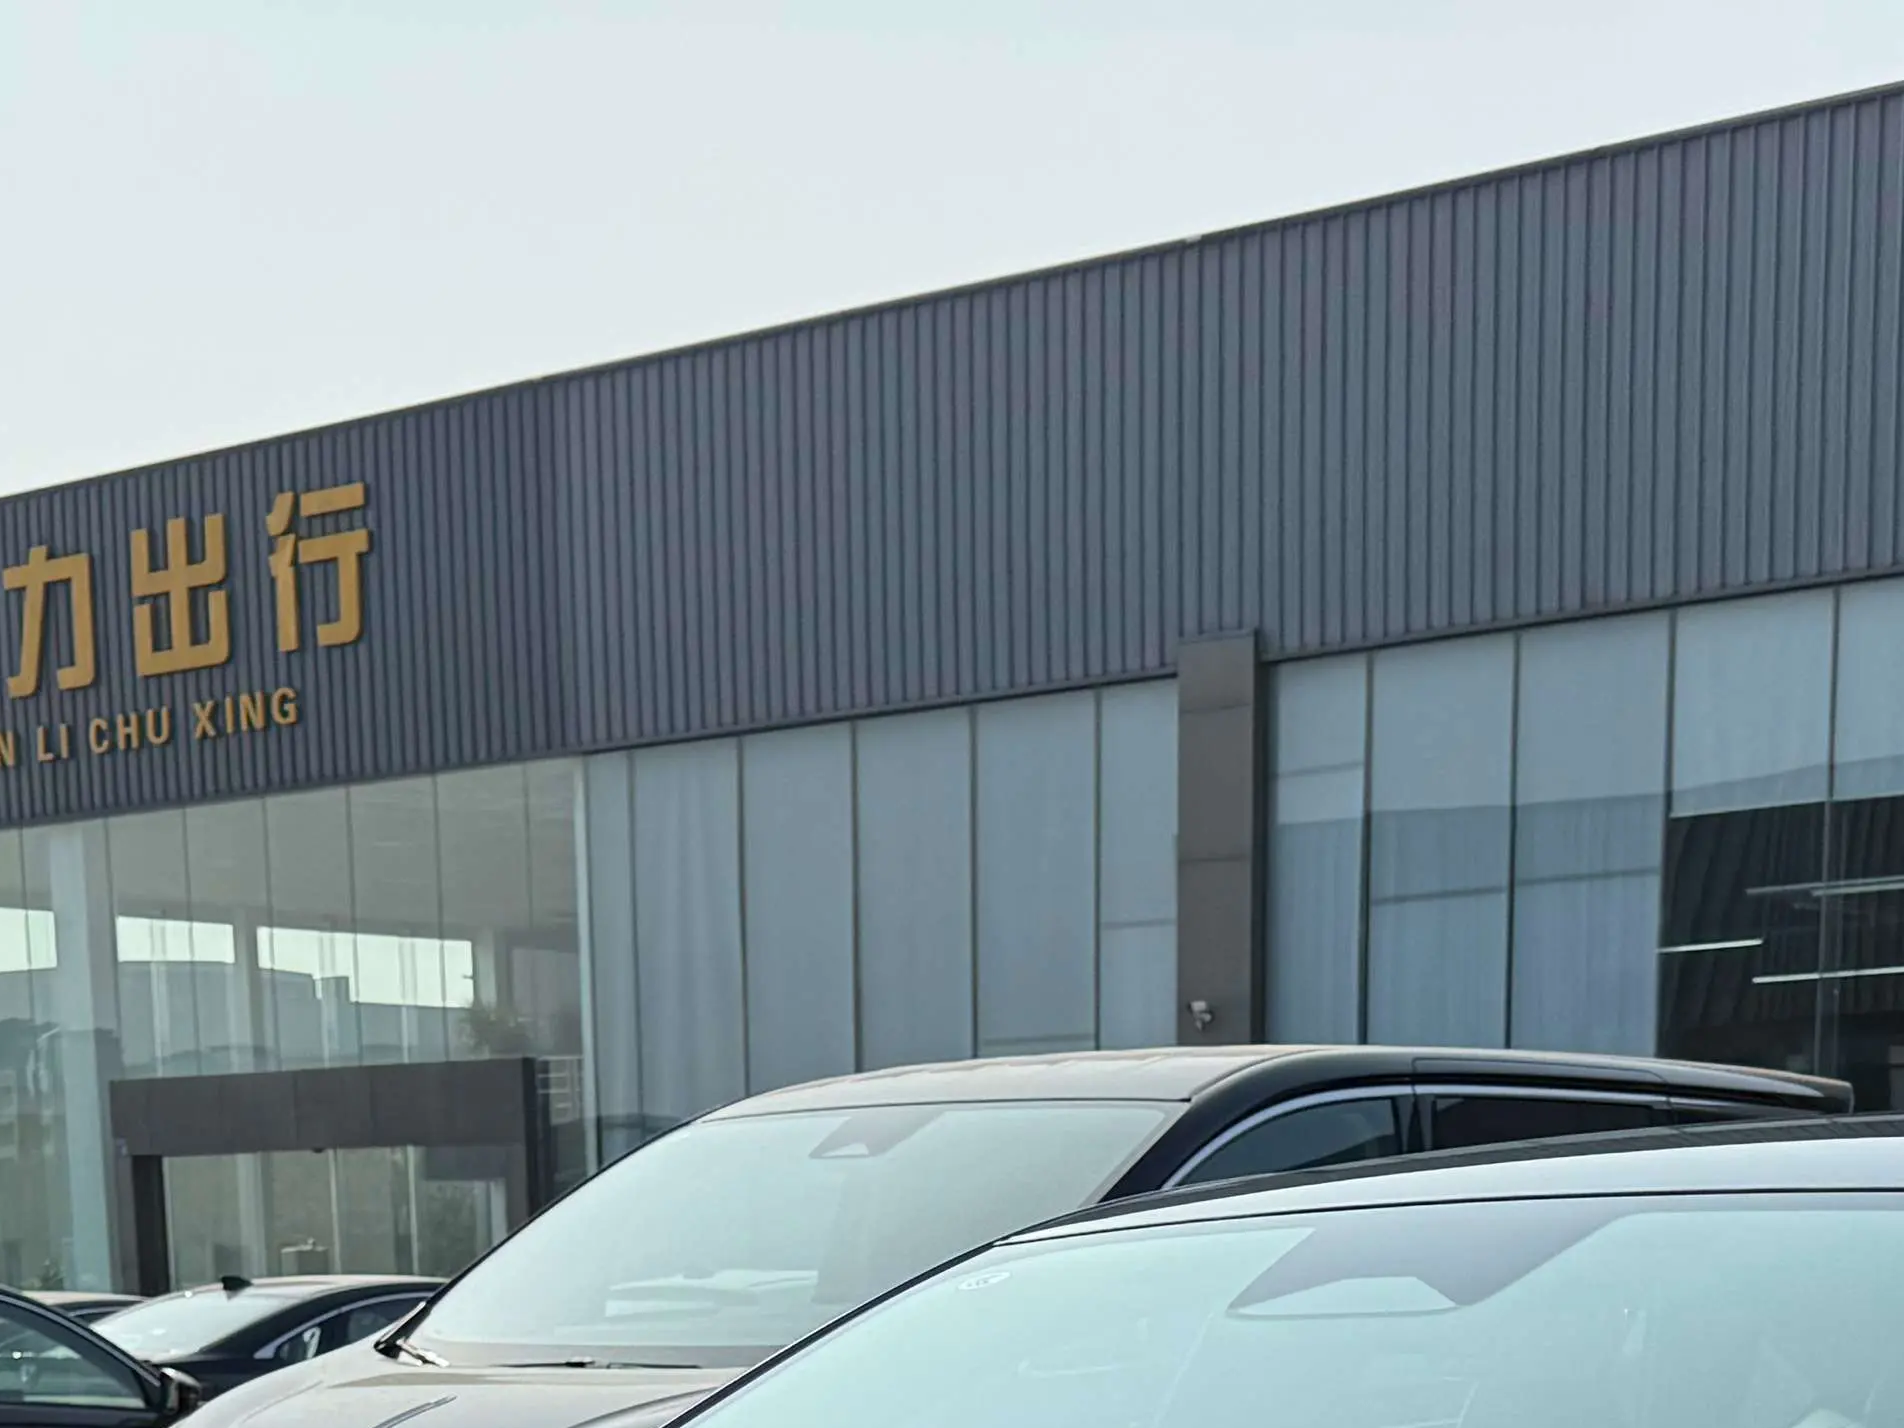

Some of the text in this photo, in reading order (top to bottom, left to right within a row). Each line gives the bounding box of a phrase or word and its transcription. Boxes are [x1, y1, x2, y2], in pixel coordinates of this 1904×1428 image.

[37, 722, 71, 763] LI
[88, 708, 170, 754] CHU
[194, 687, 299, 741] XING
